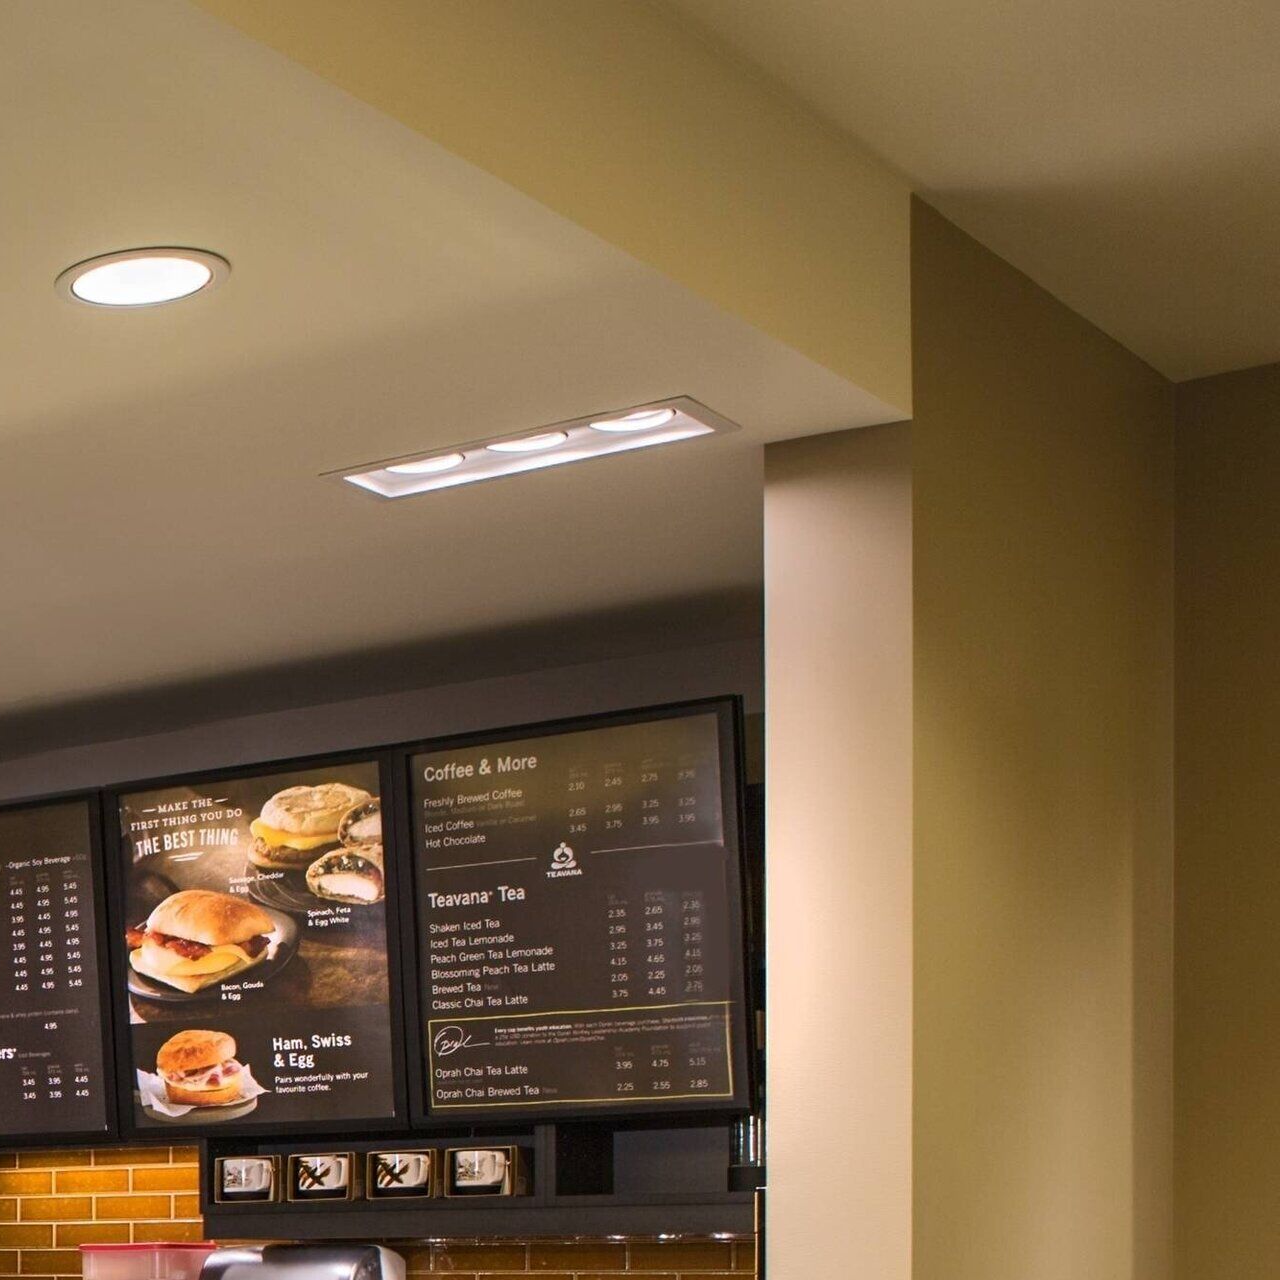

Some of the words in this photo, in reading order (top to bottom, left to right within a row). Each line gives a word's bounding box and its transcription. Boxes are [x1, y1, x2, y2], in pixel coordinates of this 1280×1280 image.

[424, 763, 474, 781] Coffee
[479, 758, 491, 774] &
[498, 756, 537, 773] More
[158, 801, 188, 814] MAKE
[191, 798, 213, 808] THE
[424, 797, 454, 808] Freshly
[457, 792, 489, 804] Brewed
[492, 788, 522, 800] Coffee
[131, 819, 159, 831] FIRST
[162, 813, 197, 826] THING
[201, 811, 222, 821] YOU
[226, 809, 242, 818] DO
[425, 822, 443, 833] Iced
[446, 820, 474, 831] Coffee
[136, 836, 161, 856] THE
[164, 830, 195, 850] BEST
[199, 828, 238, 846] THING
[426, 839, 440, 848] Hot
[444, 834, 486, 847] Chocolate
[546, 868, 582, 878] TEAVANA
[498, 886, 525, 902] Tea
[430, 924, 460, 934] Shaken
[464, 921, 481, 930] Iced
[485, 919, 500, 928] Tea
[431, 939, 448, 948] Iced
[451, 938, 465, 947] Tea
[469, 934, 514, 946] Lemonade
[431, 954, 456, 964] Peach
[459, 952, 485, 962] Green
[488, 950, 503, 959] Tea
[506, 946, 554, 958] Lemonade
[432, 968, 480, 979] Blossoming
[483, 965, 509, 975] Peach
[513, 964, 528, 973] Tea
[532, 962, 555, 972] Latte
[432, 985, 463, 994] Brewed
[466, 982, 481, 992] Tea
[228, 992, 241, 1001] Egg
[432, 1000, 462, 1010] Classic
[465, 998, 483, 1008] Chai
[487, 996, 501, 1006] Tea
[505, 995, 528, 1005] Latte
[273, 1037, 307, 1051] Ham,
[311, 1033, 351, 1048] Swiss
[274, 1054, 284, 1067] &
[289, 1052, 315, 1068] Egg
[275, 1075, 292, 1083] Pairs
[294, 1073, 334, 1082] wonderfully
[436, 1069, 461, 1080] Oprah
[464, 1067, 482, 1077] Chai
[486, 1066, 501, 1075] Tea
[505, 1064, 528, 1074] Latte
[436, 1089, 462, 1100] Oprah
[465, 1088, 484, 1098] Chai
[488, 1086, 520, 1096] Brewed
[524, 1086, 539, 1095] Tea
